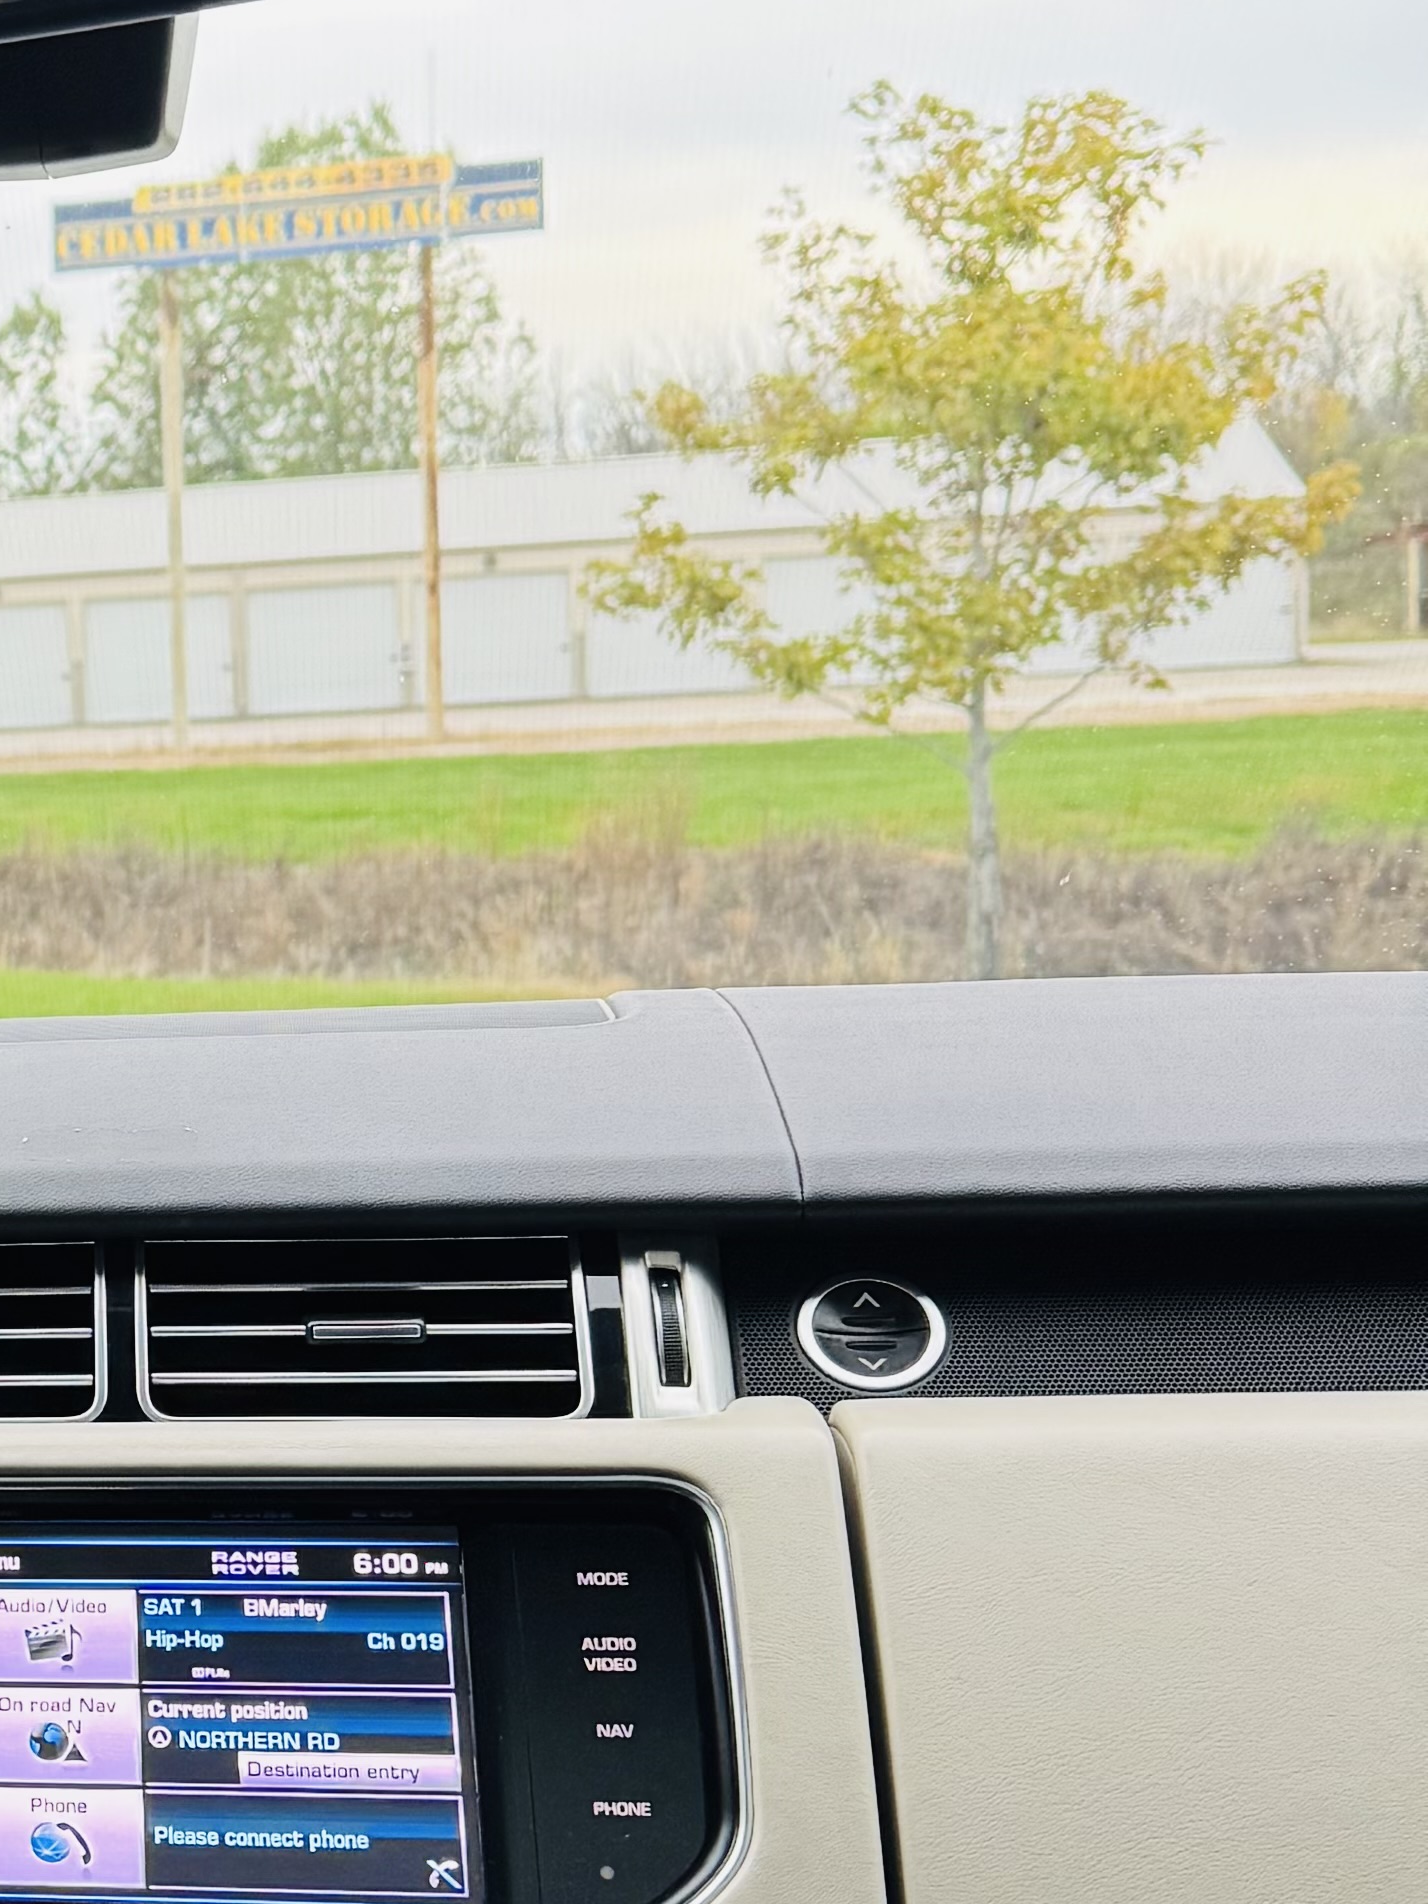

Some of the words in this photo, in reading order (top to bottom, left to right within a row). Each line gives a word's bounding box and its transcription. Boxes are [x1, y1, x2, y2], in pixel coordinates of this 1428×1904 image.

[57, 219, 178, 260] CEDAR
[186, 211, 286, 252] LAKE
[211, 1551, 298, 1563] RANGE
[353, 1552, 419, 1575] 6:00
[424, 1562, 449, 1575] PM
[211, 1563, 300, 1576] ROVER
[576, 1571, 630, 1587] MODE
[144, 1598, 185, 1616] SAT
[191, 1598, 202, 1616] 1
[244, 1598, 327, 1622] BMarley
[145, 1629, 224, 1652] Hip-Hop
[367, 1632, 396, 1650] Ch
[401, 1632, 444, 1651] 019
[581, 1636, 637, 1652] AUDIO
[583, 1657, 637, 1672] VIDEO
[30, 1695, 72, 1713] road
[79, 1697, 116, 1714] Nav
[147, 1700, 226, 1720] Current
[231, 1701, 308, 1722] position
[596, 1724, 634, 1739] NAV
[178, 1732, 302, 1750] NORTHERN
[307, 1733, 340, 1751] RD
[248, 1761, 360, 1779] Destination
[367, 1763, 420, 1784] entry
[30, 1797, 88, 1815] Phone
[593, 1801, 652, 1817] PHONE
[154, 1827, 219, 1846] Please
[225, 1829, 303, 1849] connect
[309, 1831, 370, 1852] phone
